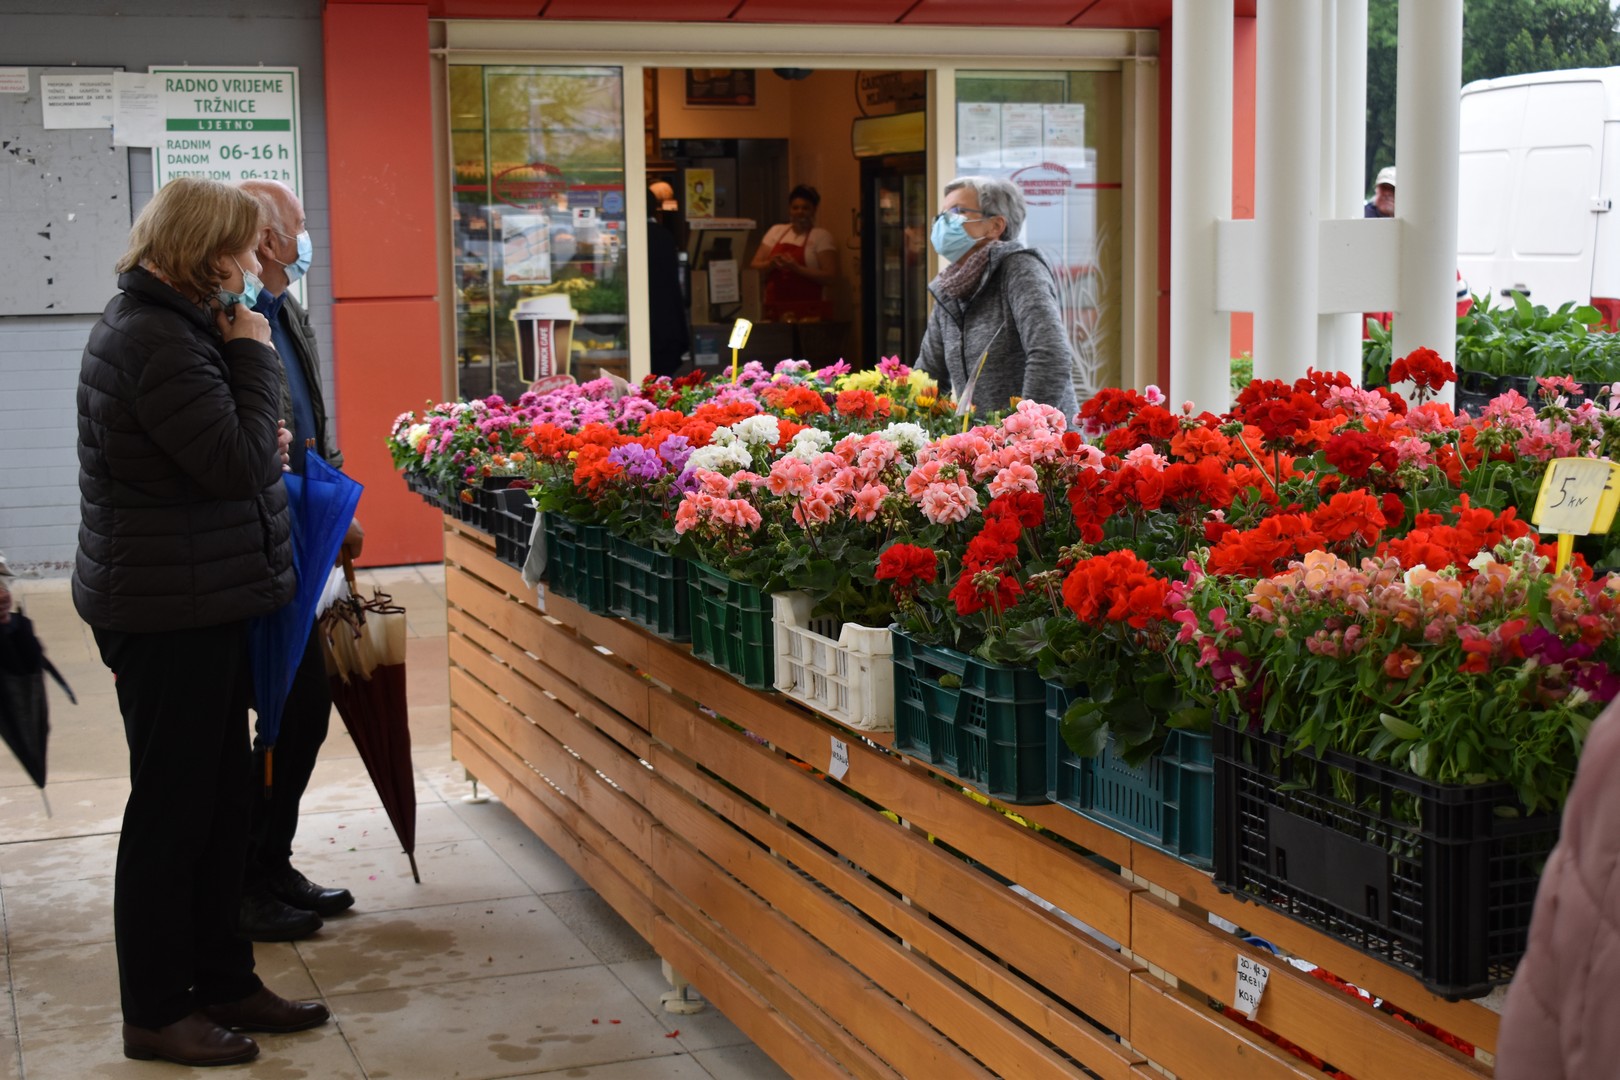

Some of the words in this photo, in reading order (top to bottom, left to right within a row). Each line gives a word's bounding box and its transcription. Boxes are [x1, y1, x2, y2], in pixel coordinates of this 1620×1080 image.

[165, 78, 218, 92] RADNO
[222, 79, 283, 93] VRIJEME
[194, 97, 256, 113] TRŽNICE
[198, 120, 254, 130] LJETNO
[167, 139, 211, 150] RADNIM
[219, 144, 273, 160] 06-16
[278, 144, 289, 160] h
[167, 154, 209, 164] DANOM
[282, 169, 290, 180] h
[540, 347, 549, 376] FRANCK
[1550, 477, 1576, 508] 5
